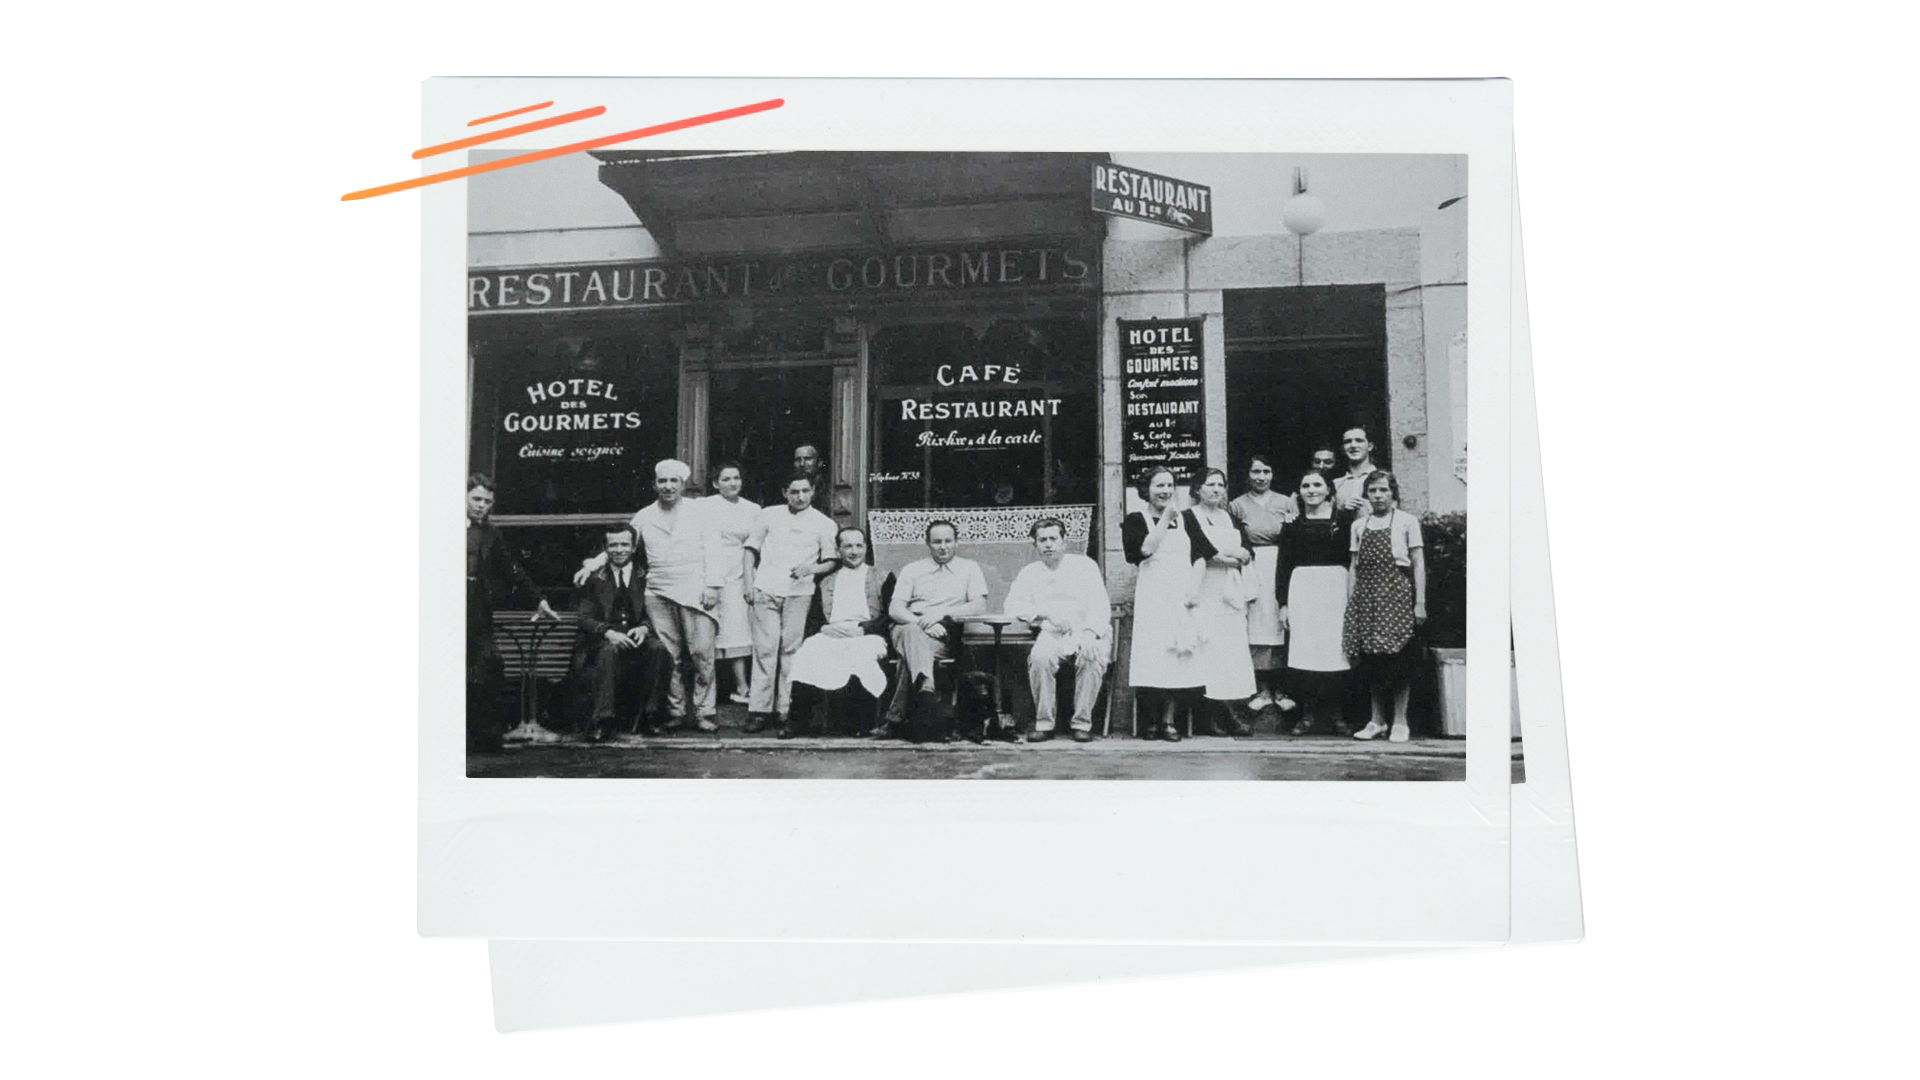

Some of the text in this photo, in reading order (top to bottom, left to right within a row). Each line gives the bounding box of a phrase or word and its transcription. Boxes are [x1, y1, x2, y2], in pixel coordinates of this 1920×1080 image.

[1096, 165, 1208, 213] RESTAURANT
[1113, 198, 1134, 213] AU
[468, 262, 758, 307] RESTAURANT
[827, 249, 1089, 291] GOURMETS
[1129, 327, 1193, 345] HOTEL
[1149, 346, 1174, 355] DES
[1126, 356, 1199, 374] GOURMETS
[936, 363, 1021, 386] CAFÉ
[526, 379, 618, 404] HOTEL
[1129, 391, 1148, 400] Son
[560, 401, 587, 409] DES
[901, 399, 1062, 420] RESTAURANT
[1127, 401, 1199, 416] RESTAURANT
[504, 412, 641, 432] GOURMETS
[988, 429, 1002, 444] la
[1005, 429, 1042, 444] carte
[1132, 431, 1172, 441] Sa Carte
[519, 443, 564, 458] Cuisine
